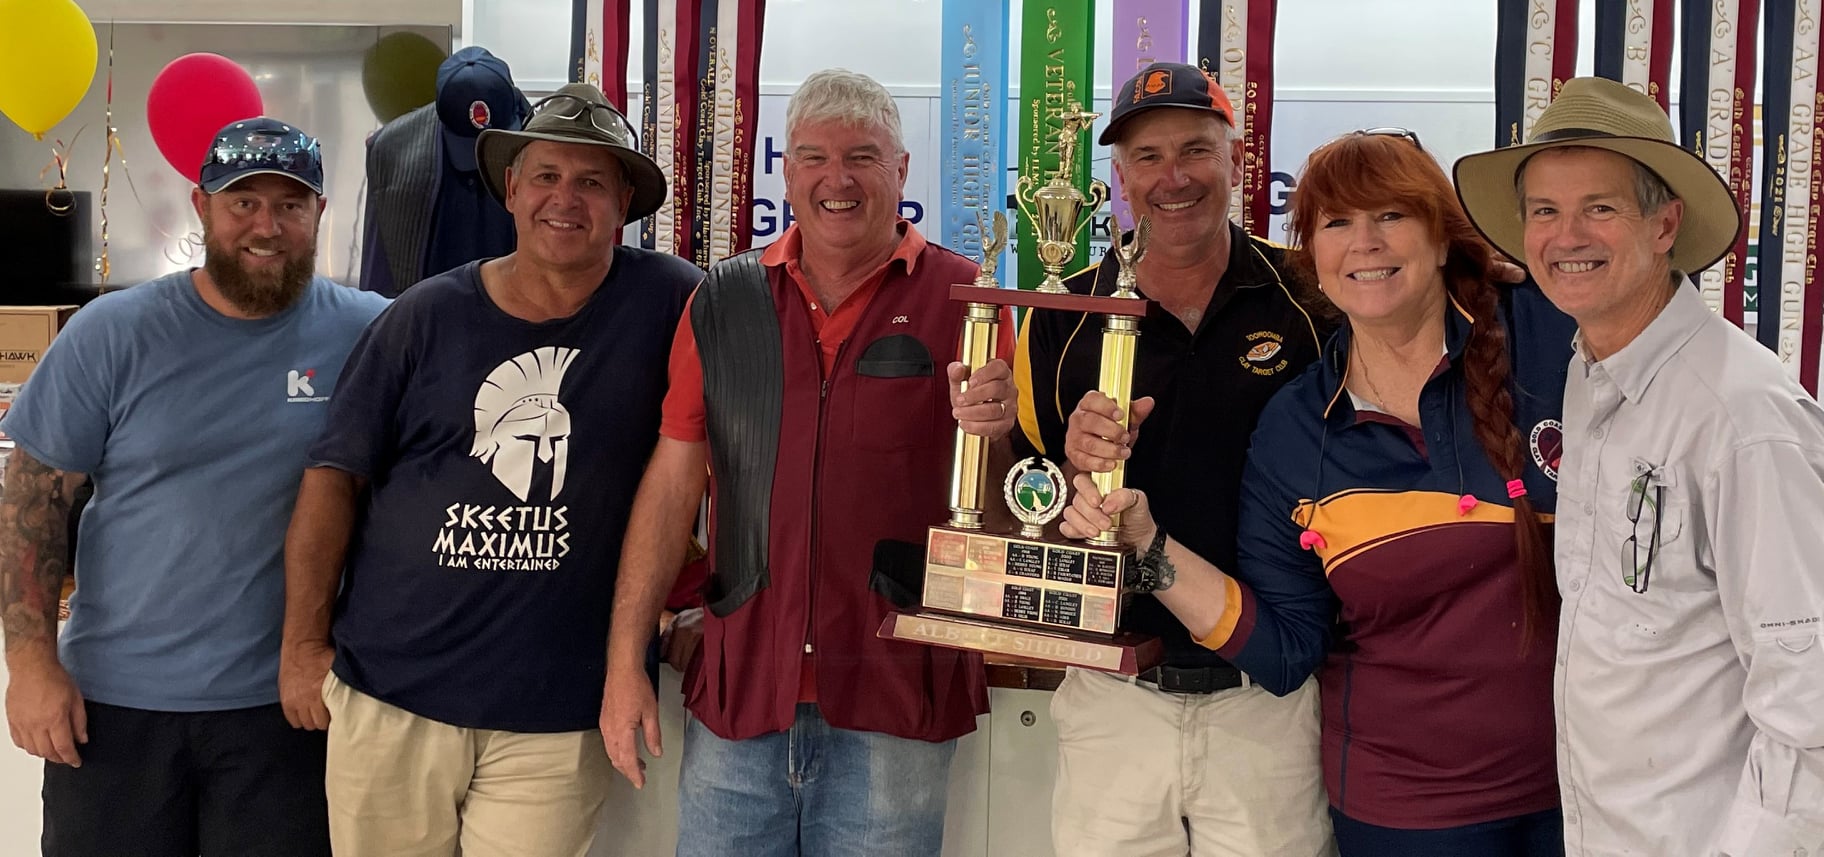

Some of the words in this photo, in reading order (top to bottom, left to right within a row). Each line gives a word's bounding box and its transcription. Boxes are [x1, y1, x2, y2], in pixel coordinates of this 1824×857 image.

[707, 36, 717, 87] OVERALL
[700, 78, 708, 100] Gold
[962, 64, 981, 141] JUNIOR
[1045, 48, 1065, 155] VETERAN
[1246, 81, 1258, 98] 50
[699, 102, 708, 126] Coast
[706, 90, 715, 133] WINNER
[1031, 98, 1041, 144] Sponsored
[1243, 102, 1257, 148] Target
[697, 128, 707, 149] Clay
[1708, 88, 1731, 175] GRADE
[1732, 123, 1744, 161] Coast
[1789, 103, 1812, 189] GRADE
[1813, 127, 1824, 165] Coast
[696, 150, 705, 180] Target
[731, 147, 742, 190] Target
[1031, 146, 1041, 156] by
[703, 160, 713, 205] Sponsored
[713, 88, 735, 259] CHAMPIONSHI
[962, 155, 980, 209] HIGH
[1774, 167, 1785, 203] 2021
[1811, 170, 1822, 201] Clay
[696, 182, 705, 204] Club
[658, 200, 673, 255] WINN
[703, 207, 711, 219] by
[1807, 204, 1820, 250] Target
[1785, 204, 1807, 264] HIGH
[1725, 252, 1737, 283] Club
[1805, 253, 1817, 285] Club
[892, 315, 909, 324] COL
[1781, 281, 1802, 331] GUN
[1531, 426, 1542, 444] GOLD
[1543, 421, 1563, 431] COAS
[1532, 446, 1543, 463] CLAY
[444, 502, 569, 532] SKEETUS
[431, 527, 571, 558] MAXIMUS
[438, 554, 443, 566] I
[446, 555, 468, 569] AM
[473, 557, 561, 571] ENTERTAINED
[913, 622, 1004, 648] ALBT
[1012, 637, 1102, 662] SHIELD
